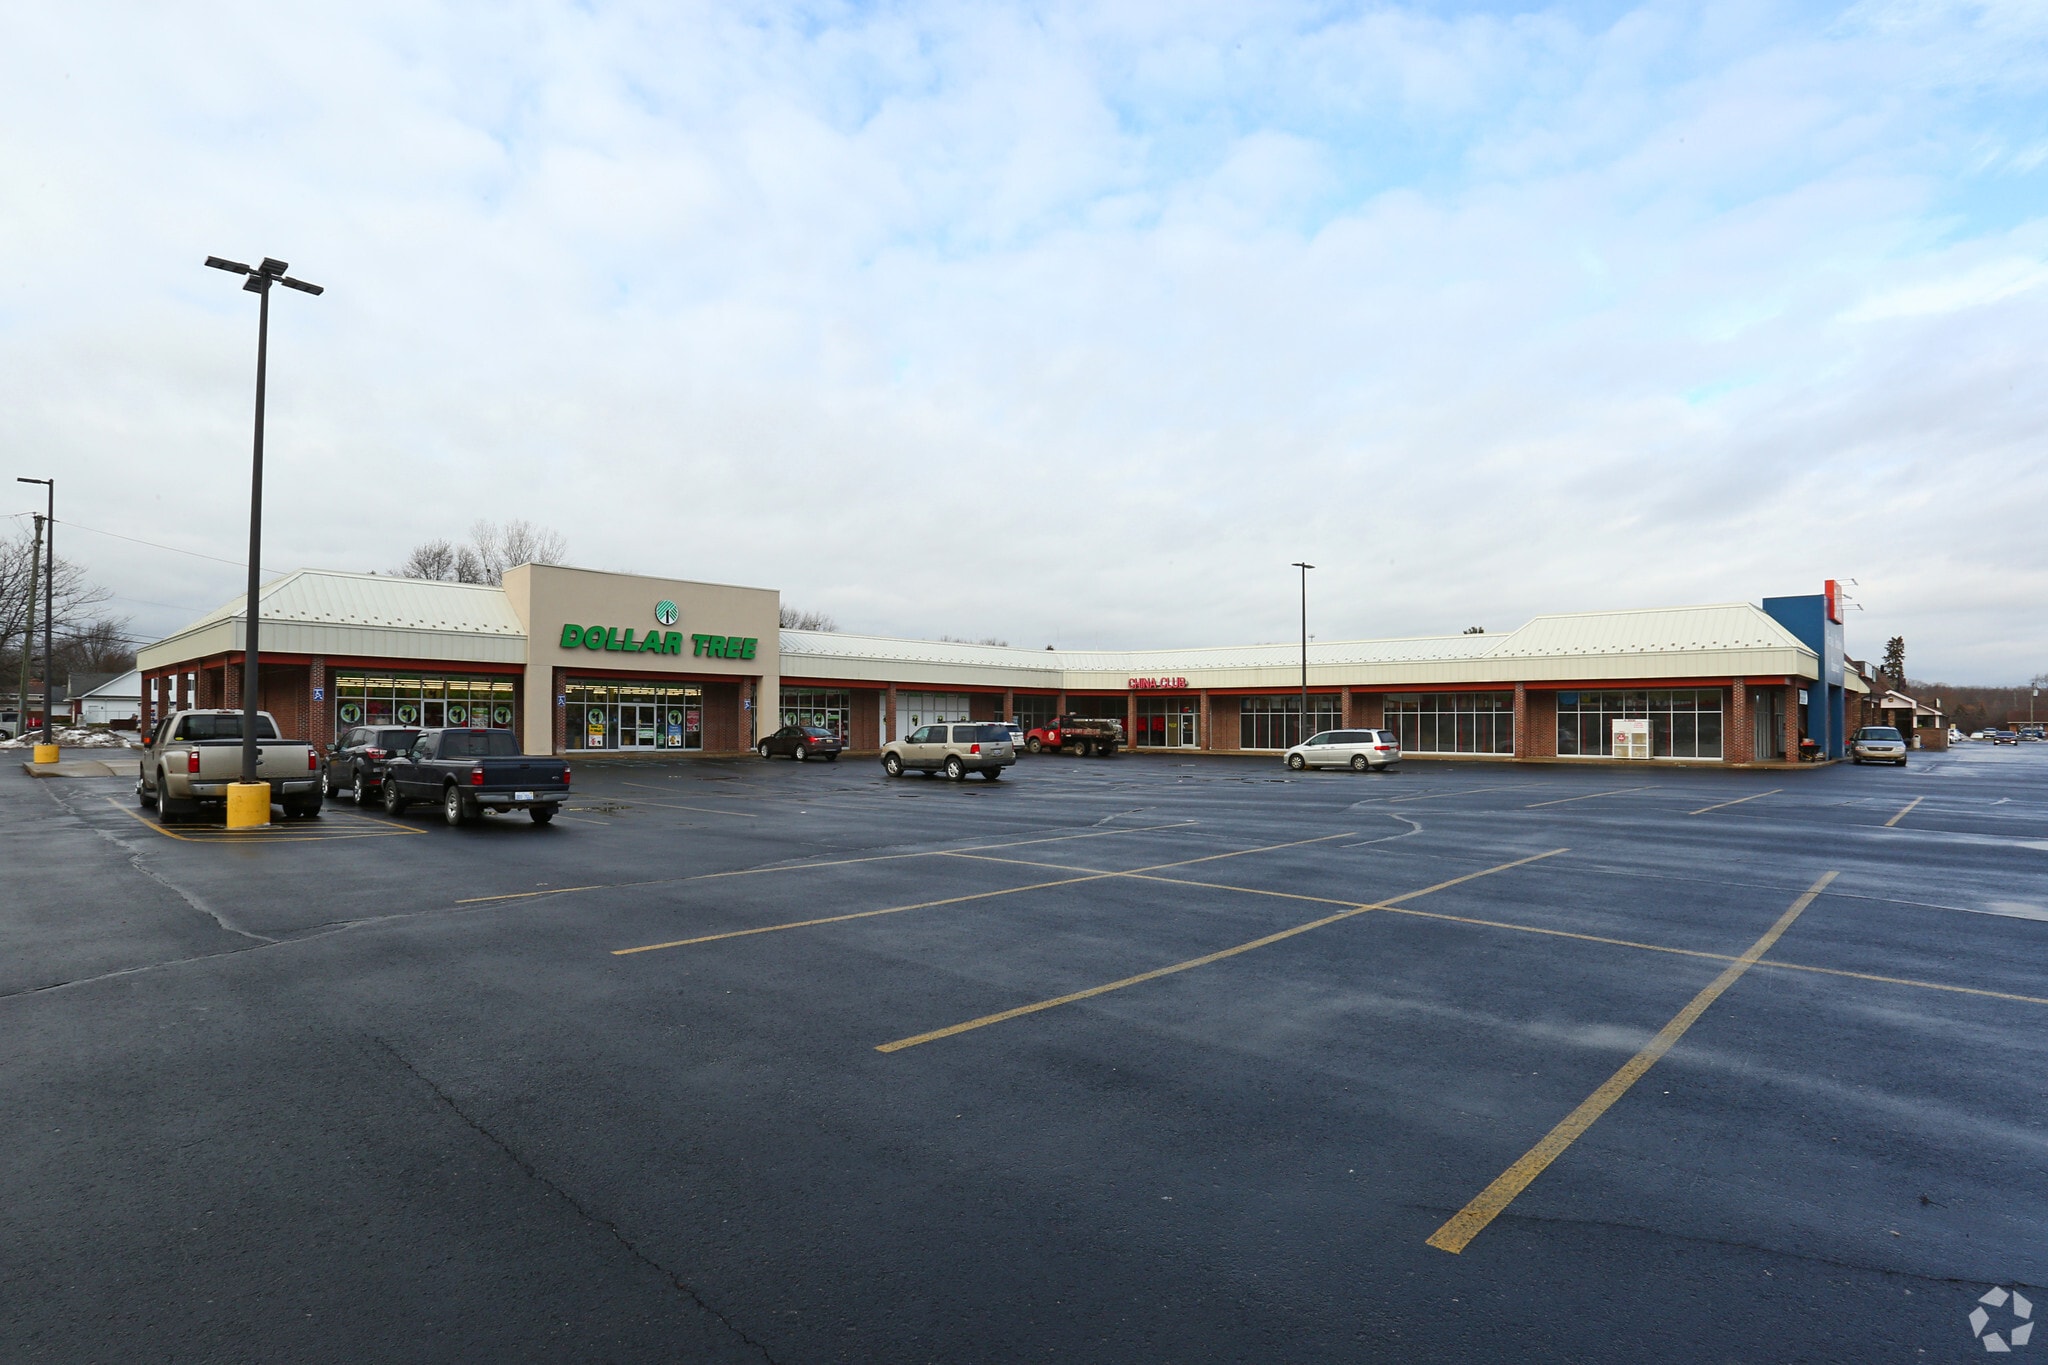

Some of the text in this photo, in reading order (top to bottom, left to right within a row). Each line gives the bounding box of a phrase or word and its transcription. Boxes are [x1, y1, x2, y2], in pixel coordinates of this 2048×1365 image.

[560, 623, 758, 659] DOLLAR TREE
[1128, 677, 1186, 688] CHINA CLUB
